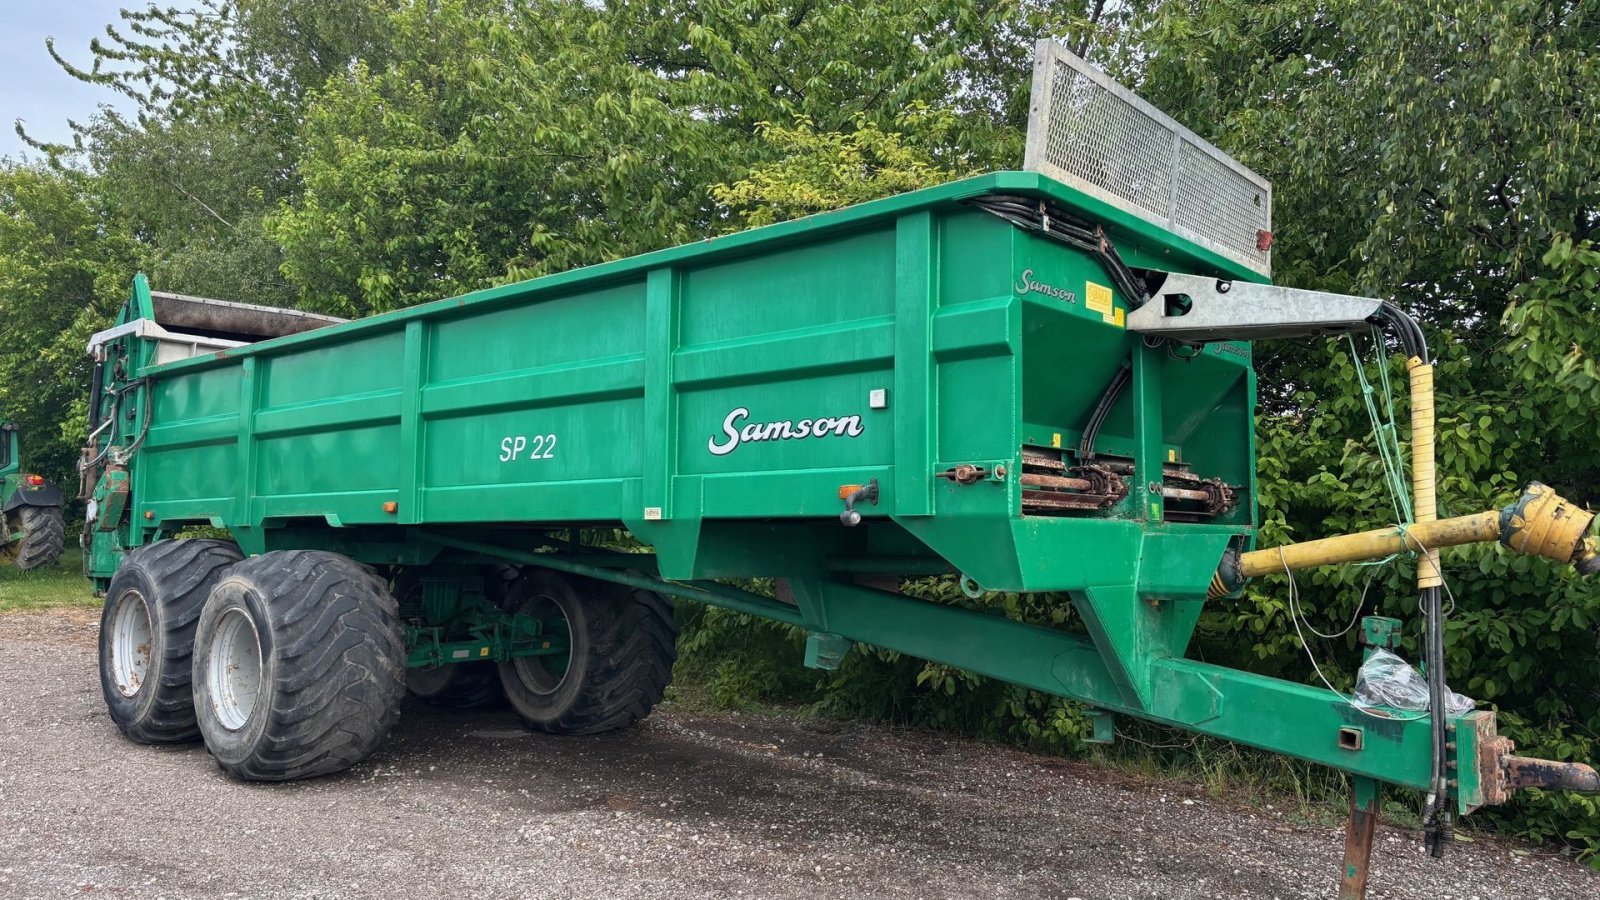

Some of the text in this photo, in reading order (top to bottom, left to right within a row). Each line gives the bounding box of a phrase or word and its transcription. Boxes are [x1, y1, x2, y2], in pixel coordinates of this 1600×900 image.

[1015, 269, 1077, 304] Samson
[499, 433, 557, 462] SP 22
[708, 407, 864, 455] Samson
